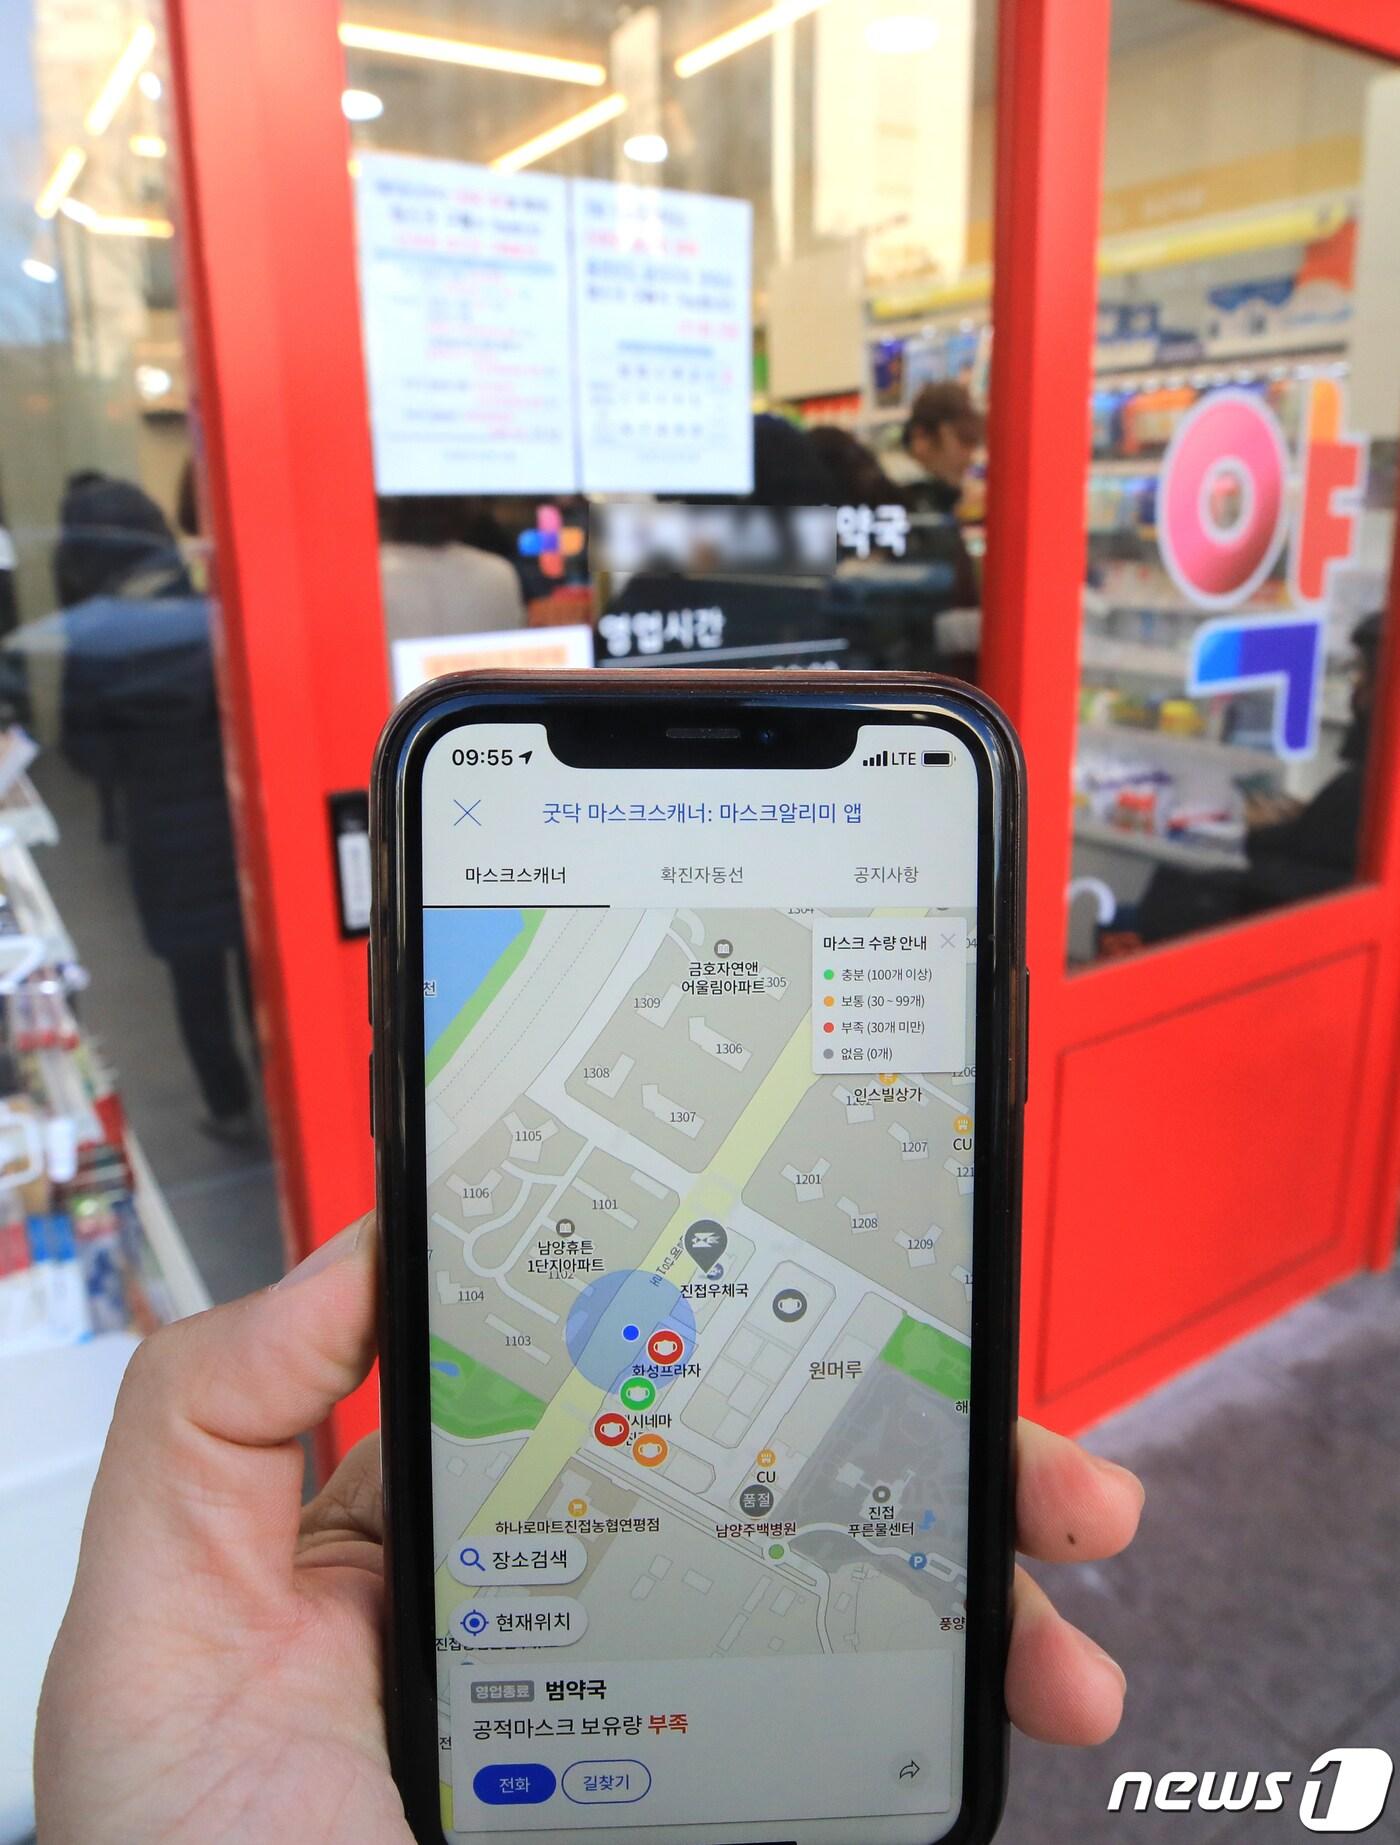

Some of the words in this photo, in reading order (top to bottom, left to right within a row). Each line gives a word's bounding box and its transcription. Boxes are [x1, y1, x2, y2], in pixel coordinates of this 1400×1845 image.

[598, 606, 726, 657] 영업시간
[451, 749, 515, 767] 09:55
[891, 751, 917, 767] LTE
[541, 802, 582, 824] 굿닥
[587, 802, 713, 825] 마스크스캐너:
[719, 802, 838, 825] 마스크알리미
[843, 802, 864, 824] 앱
[465, 865, 568, 885] 마스크스캐너
[659, 865, 745, 885] 확진자동선
[852, 865, 920, 885] 공지사항
[822, 935, 865, 951] 마스크
[868, 935, 897, 951] 수량
[899, 935, 928, 951] 안내
[688, 961, 760, 977] 금호자연앤
[841, 968, 865, 983] 충분
[866, 968, 904, 983] (100개
[905, 968, 933, 983] 이상)
[680, 980, 766, 996] 어울림아파트
[762, 976, 788, 989] 305
[633, 997, 661, 1010] 1309
[840, 994, 865, 1010] 보통
[866, 994, 885, 1010] (30
[895, 994, 926, 1010] 99개)
[841, 1021, 865, 1036] 부족
[866, 1021, 897, 1036] (30개
[898, 1021, 926, 1036] 미만)
[715, 1042, 743, 1055] 1306
[840, 1047, 865, 1062] 없음
[866, 1047, 893, 1062] (0개)
[583, 1067, 610, 1080] 1308
[854, 1087, 923, 1103] 인스빌상가
[670, 1111, 697, 1124] 1307
[514, 1130, 542, 1143] 1105
[952, 1138, 973, 1151] CU
[901, 1141, 928, 1153] 1207
[795, 1173, 822, 1186] 1201
[462, 1187, 490, 1199] 1106
[591, 1199, 619, 1211] 1101
[851, 1217, 879, 1229] 1208
[537, 1240, 594, 1256] 남양휴튼
[907, 1238, 934, 1251] 1209
[527, 1257, 605, 1274] 1단지아파트
[458, 1290, 485, 1302] 1104
[680, 1283, 749, 1299] 진접우체국
[504, 1335, 532, 1347] 1103
[631, 1363, 702, 1379] 화성프라자
[809, 1360, 864, 1380] 원머루
[626, 1413, 672, 1429] 시네마
[756, 1470, 776, 1484] CU
[743, 1491, 771, 1508] 품절
[868, 1505, 895, 1520] 진접
[495, 1517, 661, 1535] 하나로마트진접농협연평점
[716, 1521, 797, 1539] 남양주백병원
[848, 1522, 915, 1537] 푸른물센터
[491, 1548, 569, 1571] 장소검색
[495, 1611, 571, 1633] 현재위치
[545, 1679, 607, 1702] 범약국
[472, 1717, 576, 1741] 공적마스크
[580, 1714, 643, 1737] 보유량
[647, 1713, 689, 1736] 부족
[499, 1776, 531, 1794] 전화
[583, 1773, 630, 1792] 길찾기
